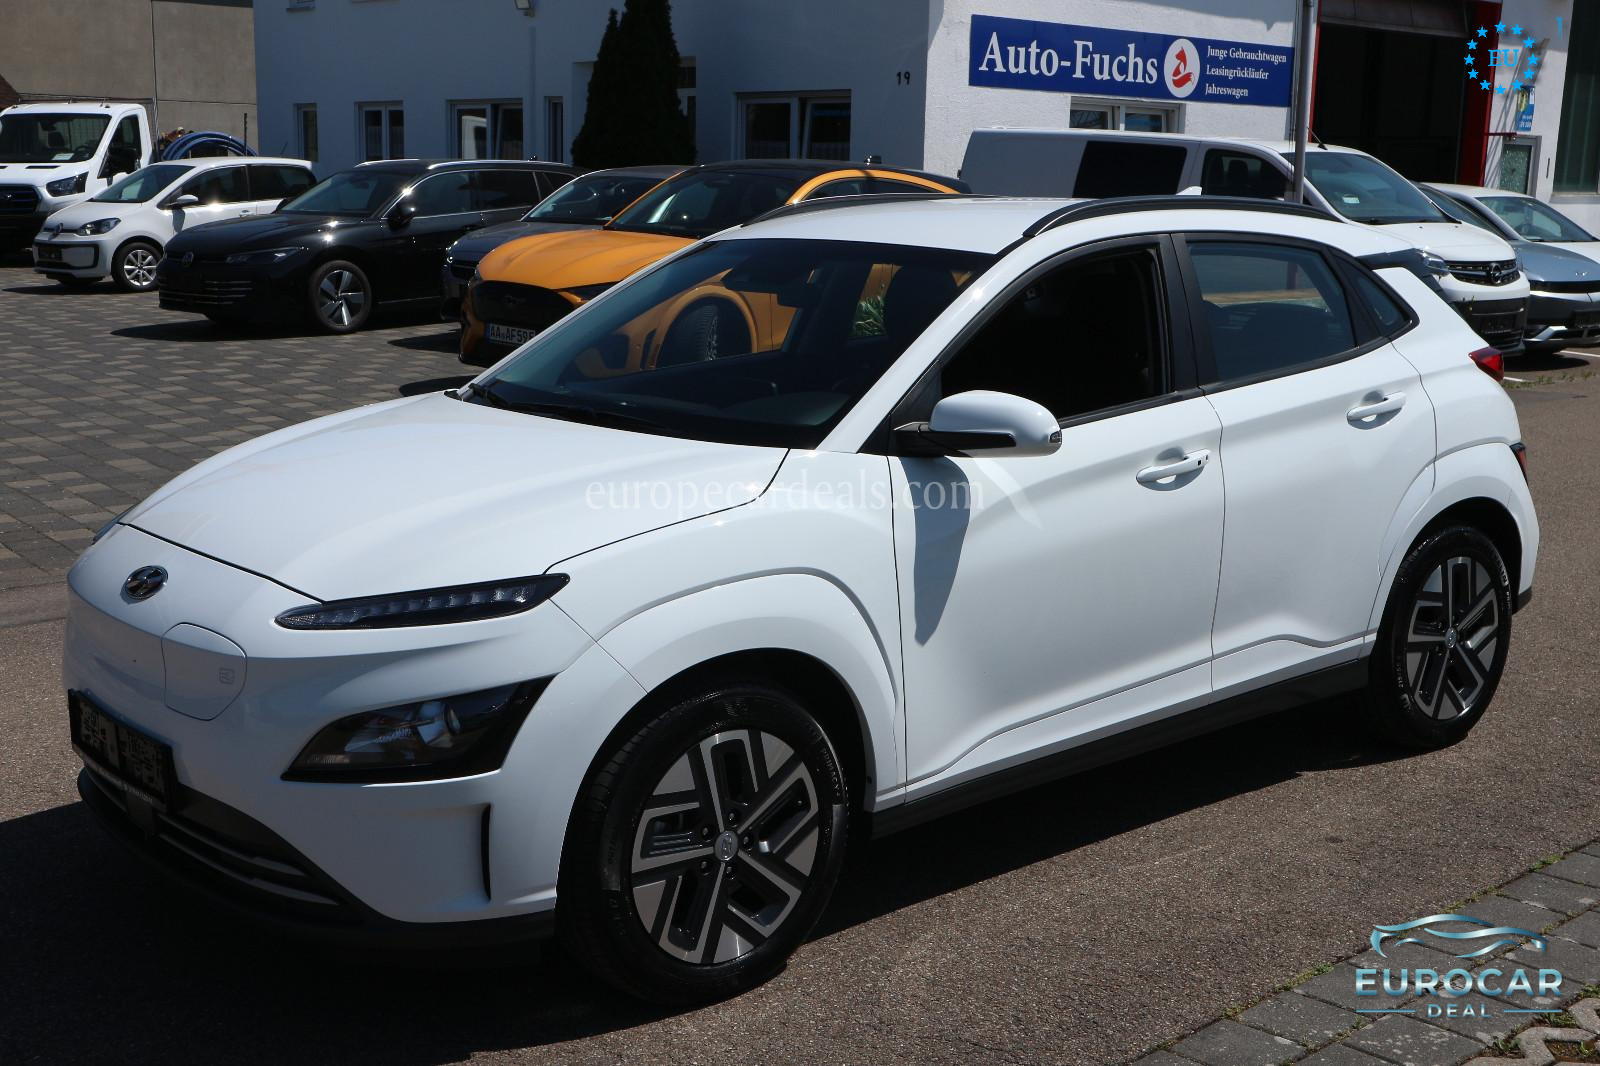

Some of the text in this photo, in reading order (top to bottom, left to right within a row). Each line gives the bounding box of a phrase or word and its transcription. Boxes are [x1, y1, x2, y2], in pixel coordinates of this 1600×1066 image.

[979, 31, 1158, 84] Auto-Fuchs
[1206, 45, 1287, 65] Junge Gebrauchtwagen
[896, 71, 911, 86] 19
[1206, 64, 1270, 81] Leasingrückläufer
[1204, 83, 1249, 98] Jahreswagen
